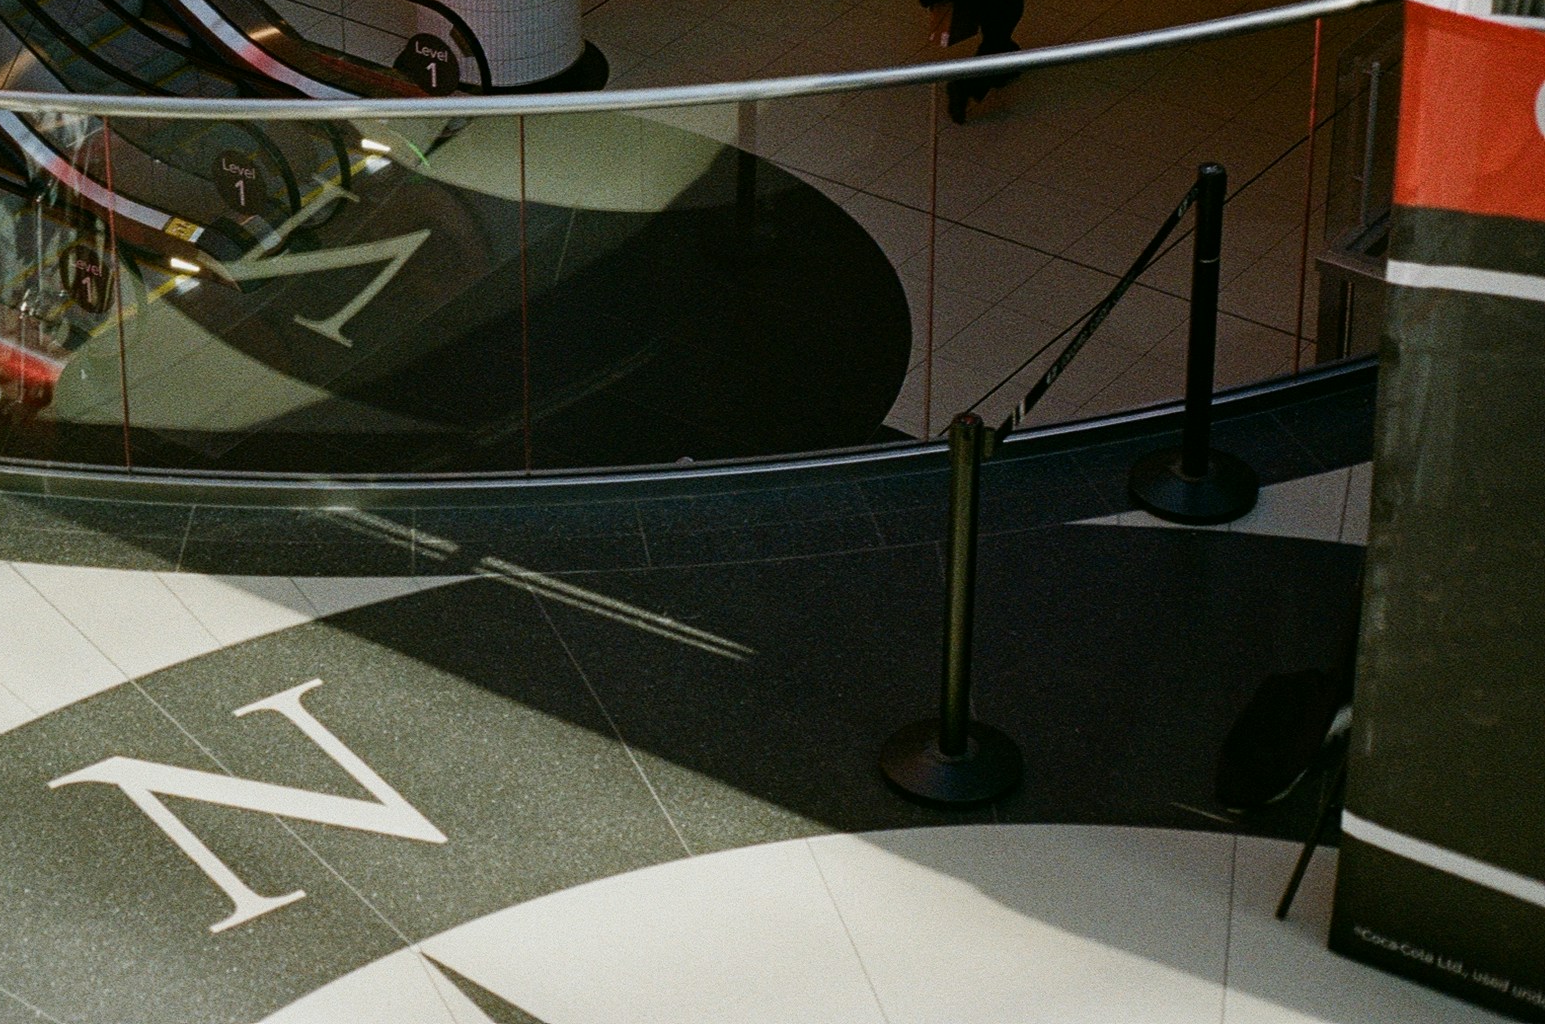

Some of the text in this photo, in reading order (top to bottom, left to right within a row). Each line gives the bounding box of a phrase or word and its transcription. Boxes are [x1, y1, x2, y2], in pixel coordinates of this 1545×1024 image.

[415, 40, 448, 63] Level
[426, 62, 437, 88] 1
[222, 158, 256, 180] Level
[235, 179, 245, 206] 1
[70, 257, 103, 278] evel
[81, 277, 92, 304] 1
[48, 678, 448, 934] N
